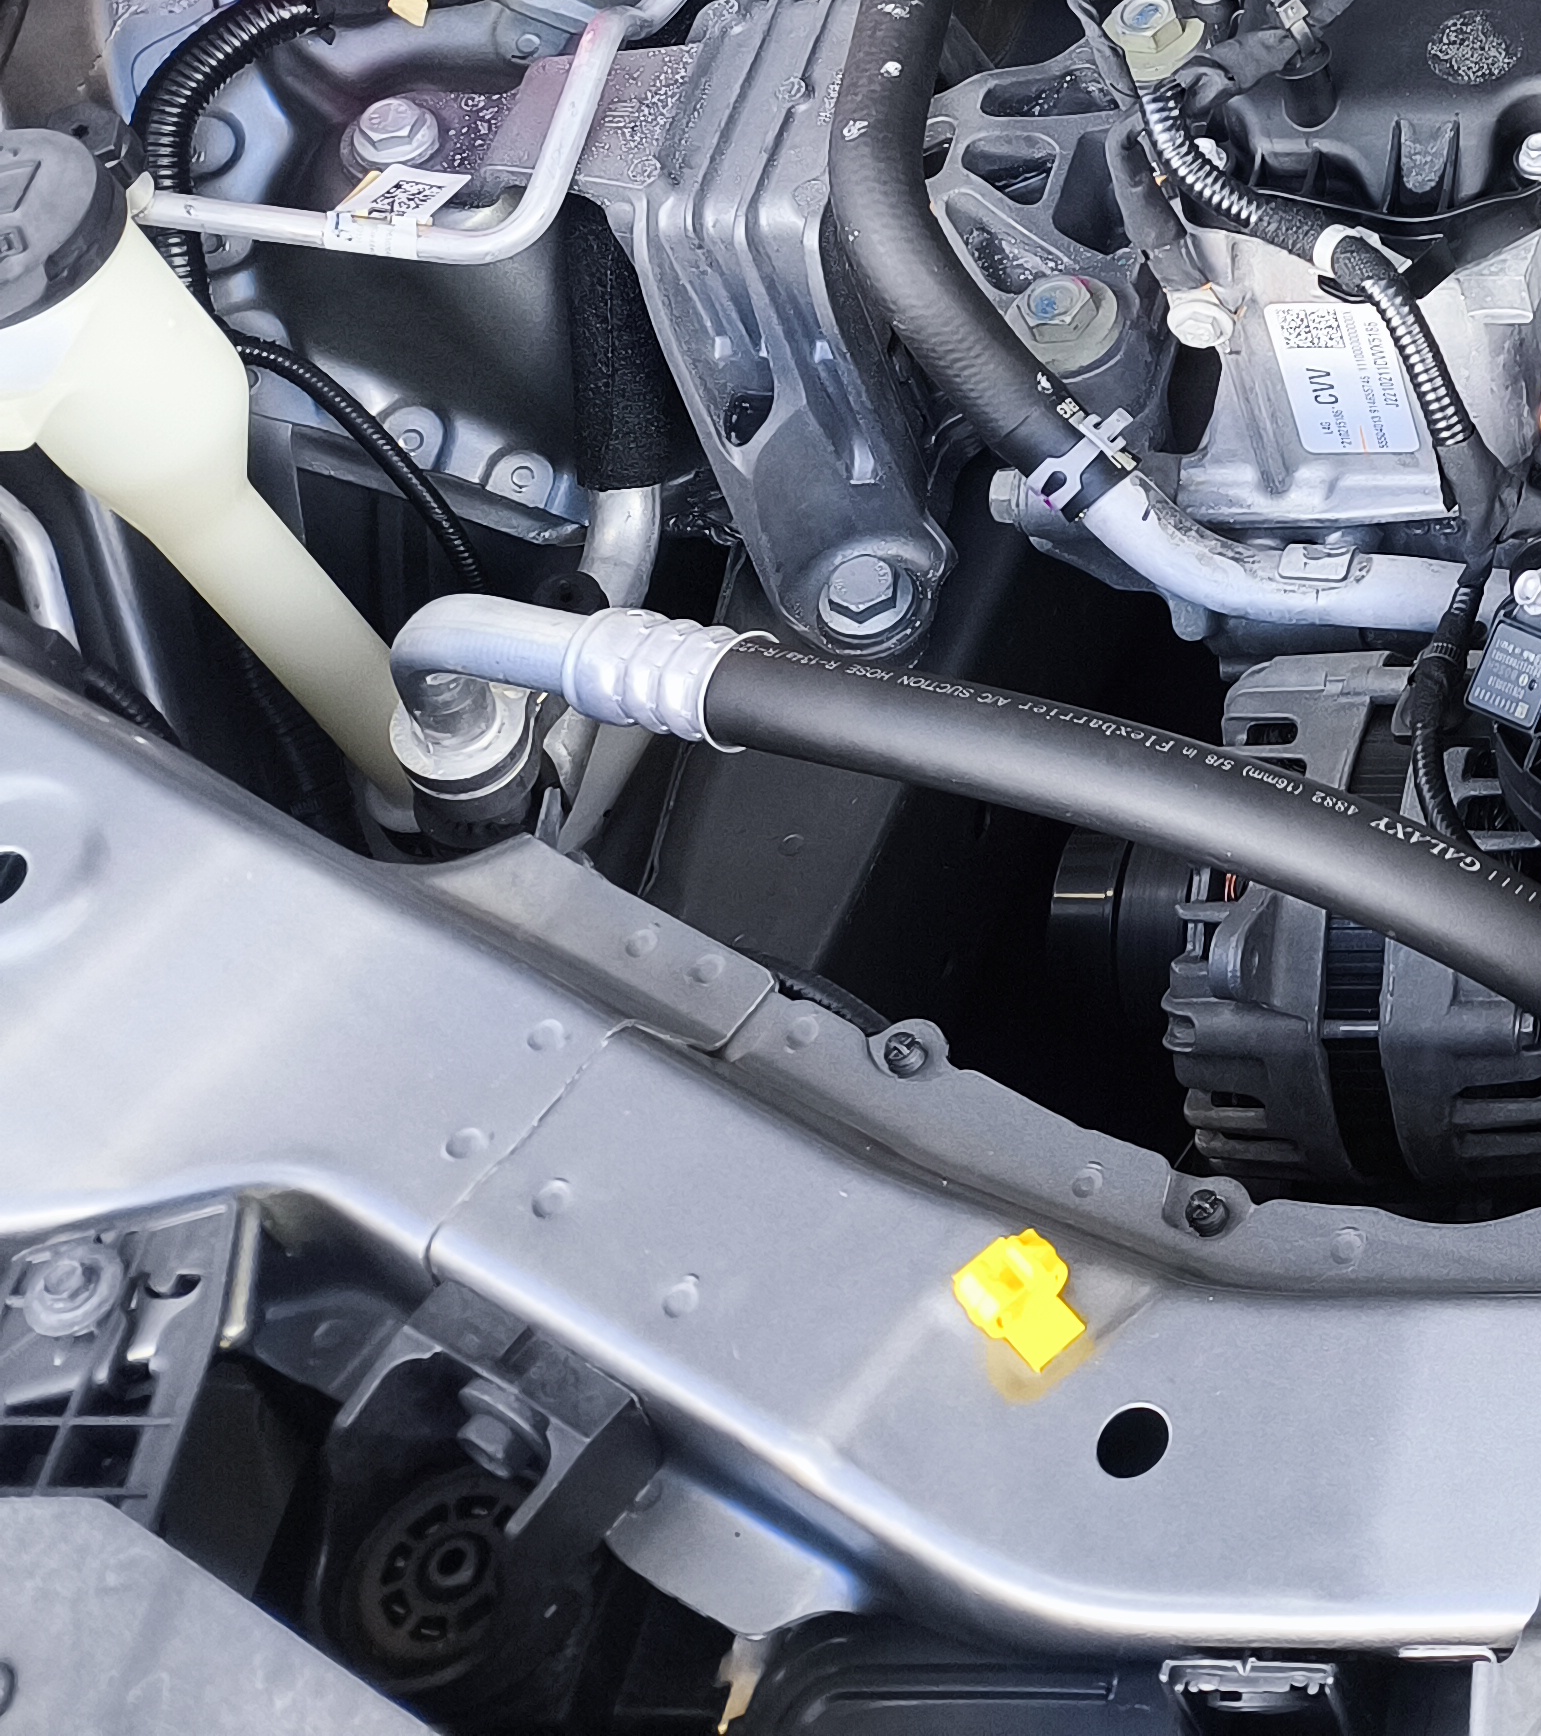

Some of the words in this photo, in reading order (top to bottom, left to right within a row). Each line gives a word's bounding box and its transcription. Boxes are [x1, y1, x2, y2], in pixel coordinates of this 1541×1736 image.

[1306, 367, 1339, 405] CVV
[845, 664, 893, 681] HOSE
[897, 674, 976, 699] SUCTION
[977, 692, 1012, 707] A/C
[1018, 701, 1176, 753] Flexbarrier
[1182, 744, 1198, 759] in
[1204, 753, 1235, 772] 5/8
[1242, 765, 1303, 795] (16mm)
[1311, 790, 1360, 816] 4882
[1369, 816, 1481, 872] GALAXY
